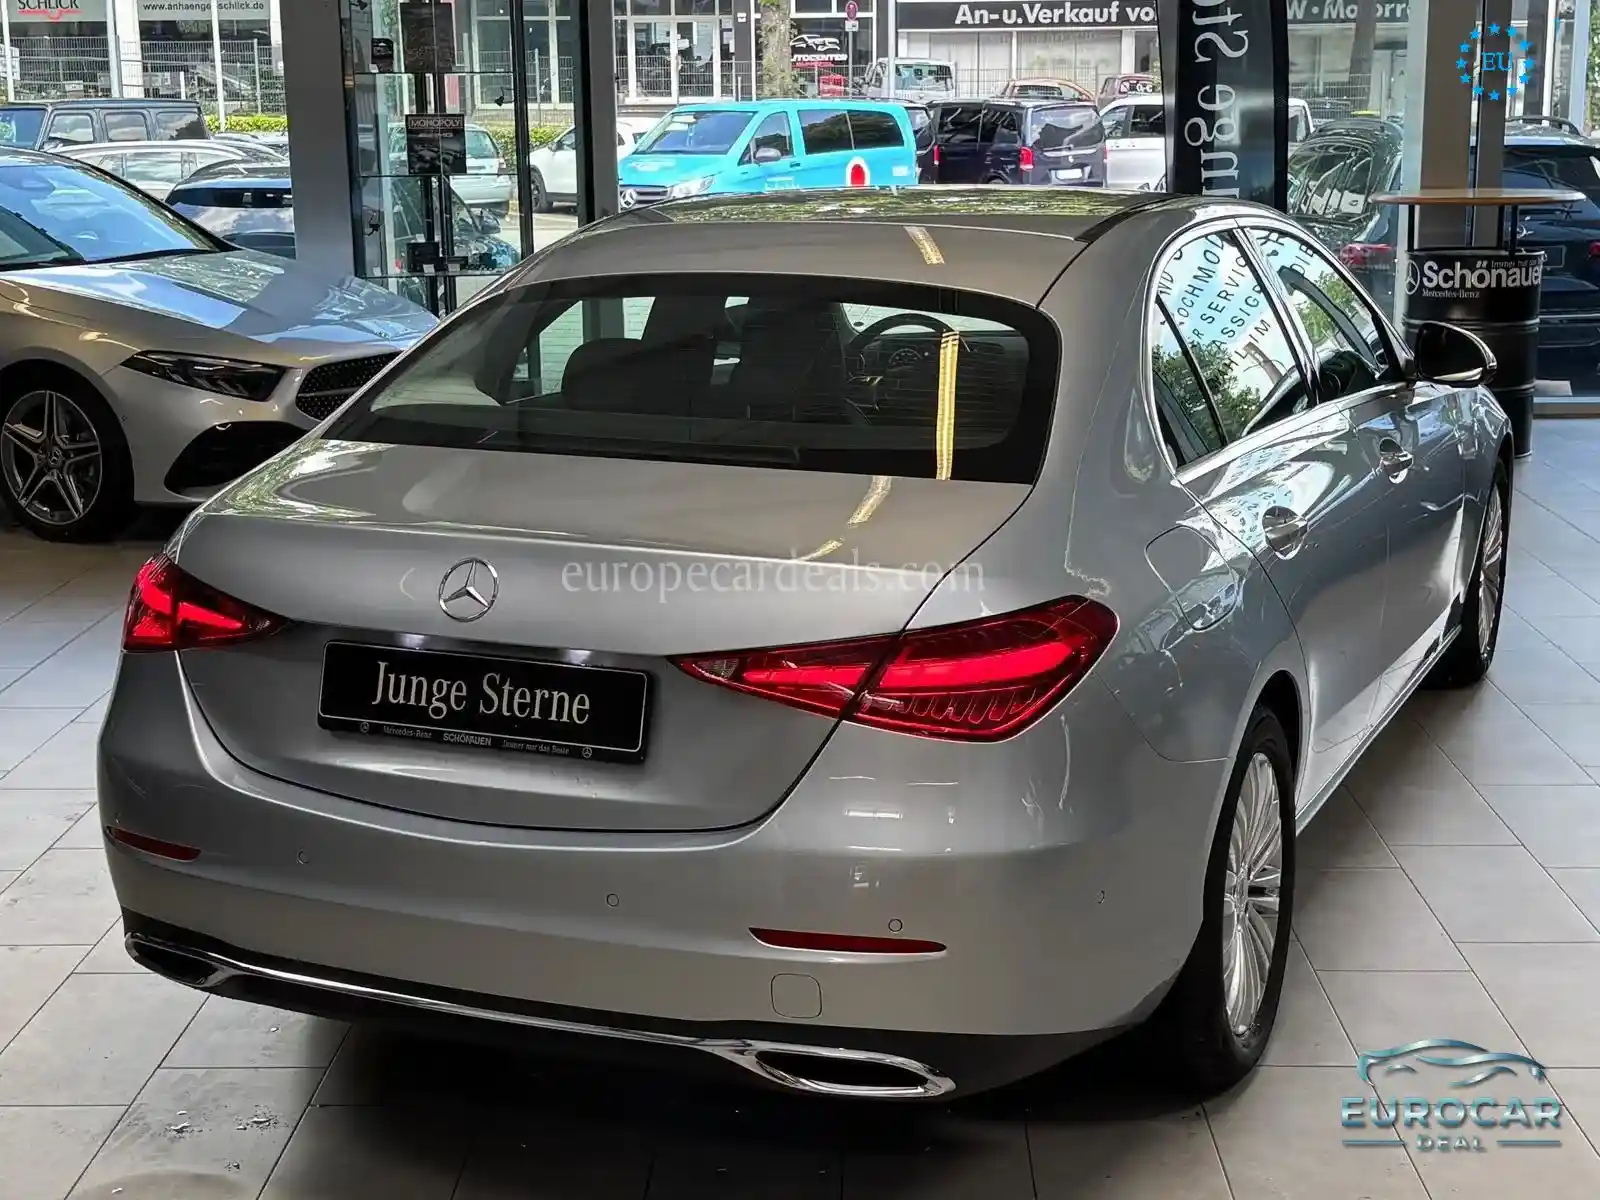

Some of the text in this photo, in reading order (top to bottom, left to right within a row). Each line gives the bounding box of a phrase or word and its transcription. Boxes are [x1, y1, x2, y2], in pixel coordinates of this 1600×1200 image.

[18, 0, 79, 9] SCHLICK
[1126, 7, 1157, 22] vo
[411, 119, 462, 128] MONOPOLY
[1422, 288, 1480, 299] Mercedes-Benz
[372, 661, 590, 725] Junge Sterne
